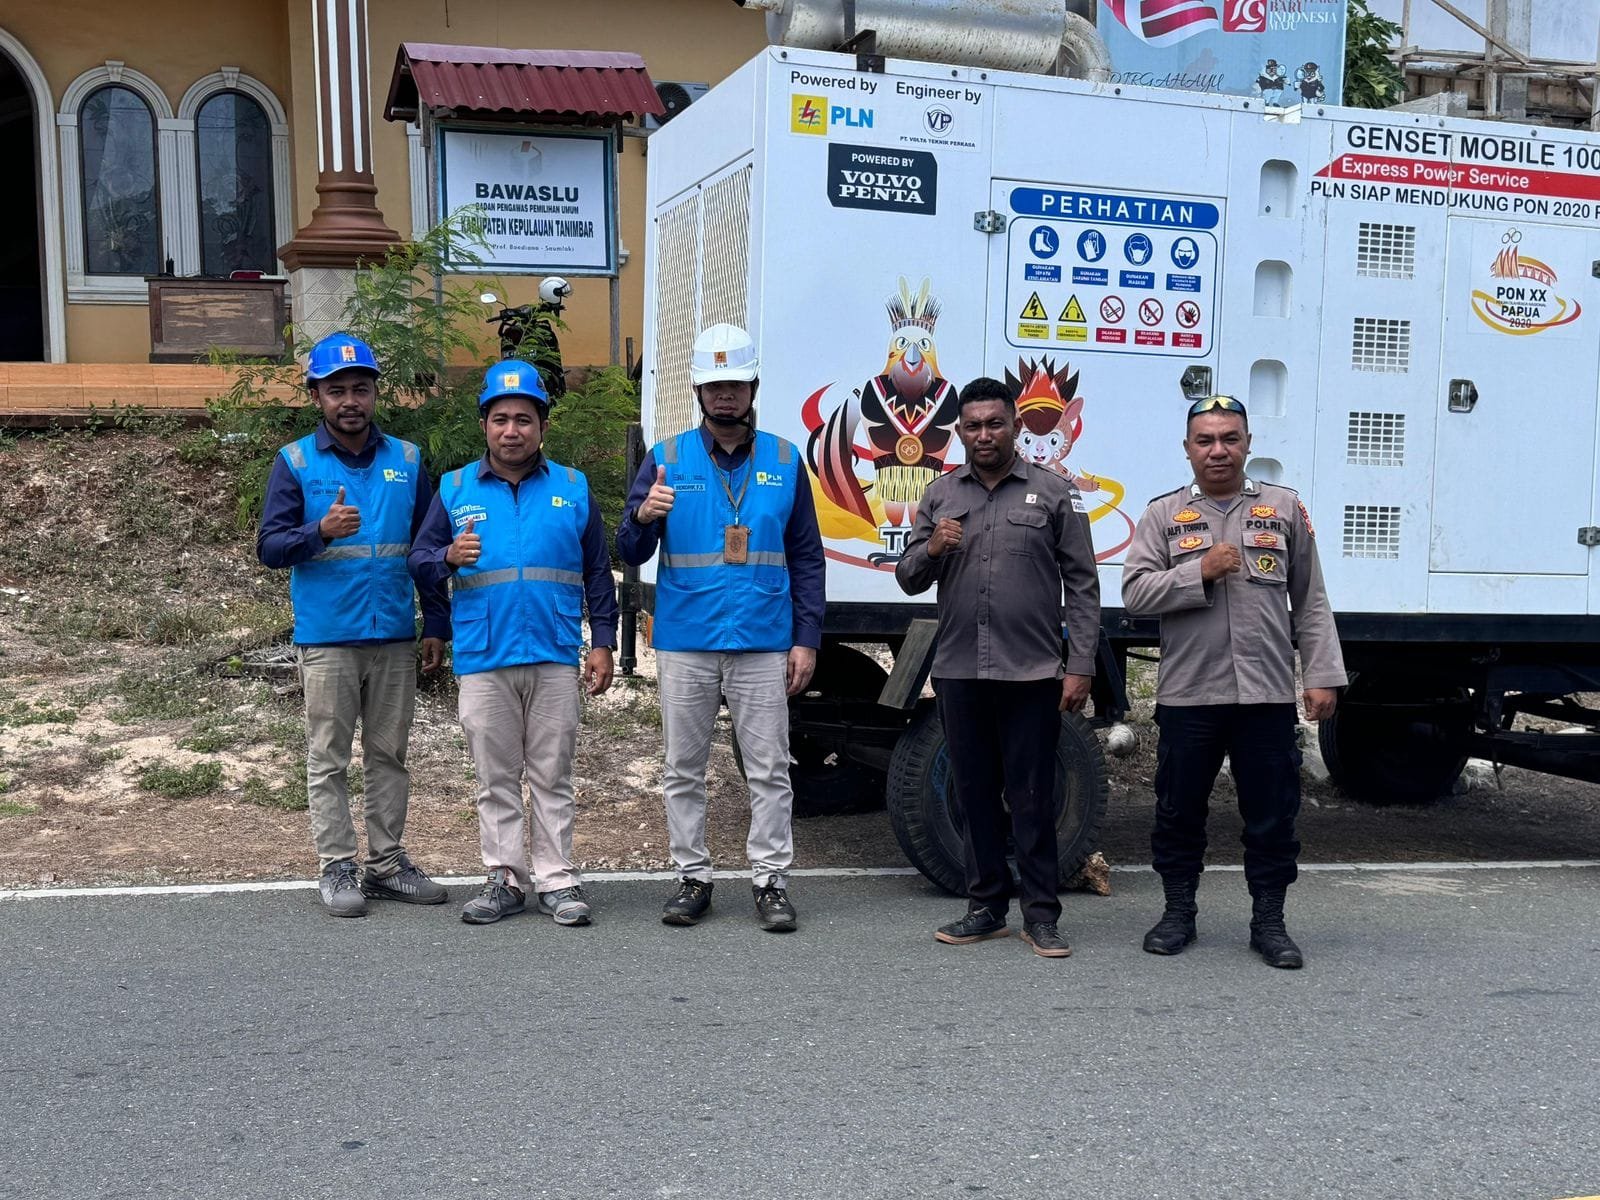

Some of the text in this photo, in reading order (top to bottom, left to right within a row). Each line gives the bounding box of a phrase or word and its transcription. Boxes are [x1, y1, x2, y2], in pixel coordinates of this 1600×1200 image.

[1270, 11, 1337, 24] INDONESIA
[791, 71, 877, 94] Powered by
[896, 82, 982, 104] Engineer by
[831, 105, 874, 128] PLN
[926, 111, 952, 129] VP
[1347, 125, 1452, 156] GENSET
[1460, 135, 1555, 167] MOBILE
[851, 153, 915, 168] POWERED BY
[840, 170, 922, 189] VOLVO
[1342, 157, 1530, 189] Express Power Service
[475, 183, 579, 202] BAWASLU
[838, 184, 925, 204] PENTA
[1310, 181, 1345, 199] PLN
[1350, 184, 1391, 202] SIAP
[1395, 187, 1508, 213] MENDUKUNG
[1513, 198, 1548, 216] PON
[1553, 201, 1591, 219] 2020
[496, 203, 529, 213] PENGAWAS
[529, 204, 560, 214] PEMILIHAN
[561, 206, 579, 215] UMUM
[1041, 194, 1193, 224] PERHATIAN
[508, 218, 554, 237] KEPULAUAN
[555, 220, 594, 238] TANIMBAR
[1497, 286, 1547, 302] PON XX
[1501, 305, 1540, 318] PAPUA
[1509, 317, 1532, 328] 2020
[1246, 520, 1281, 531] POLRI
